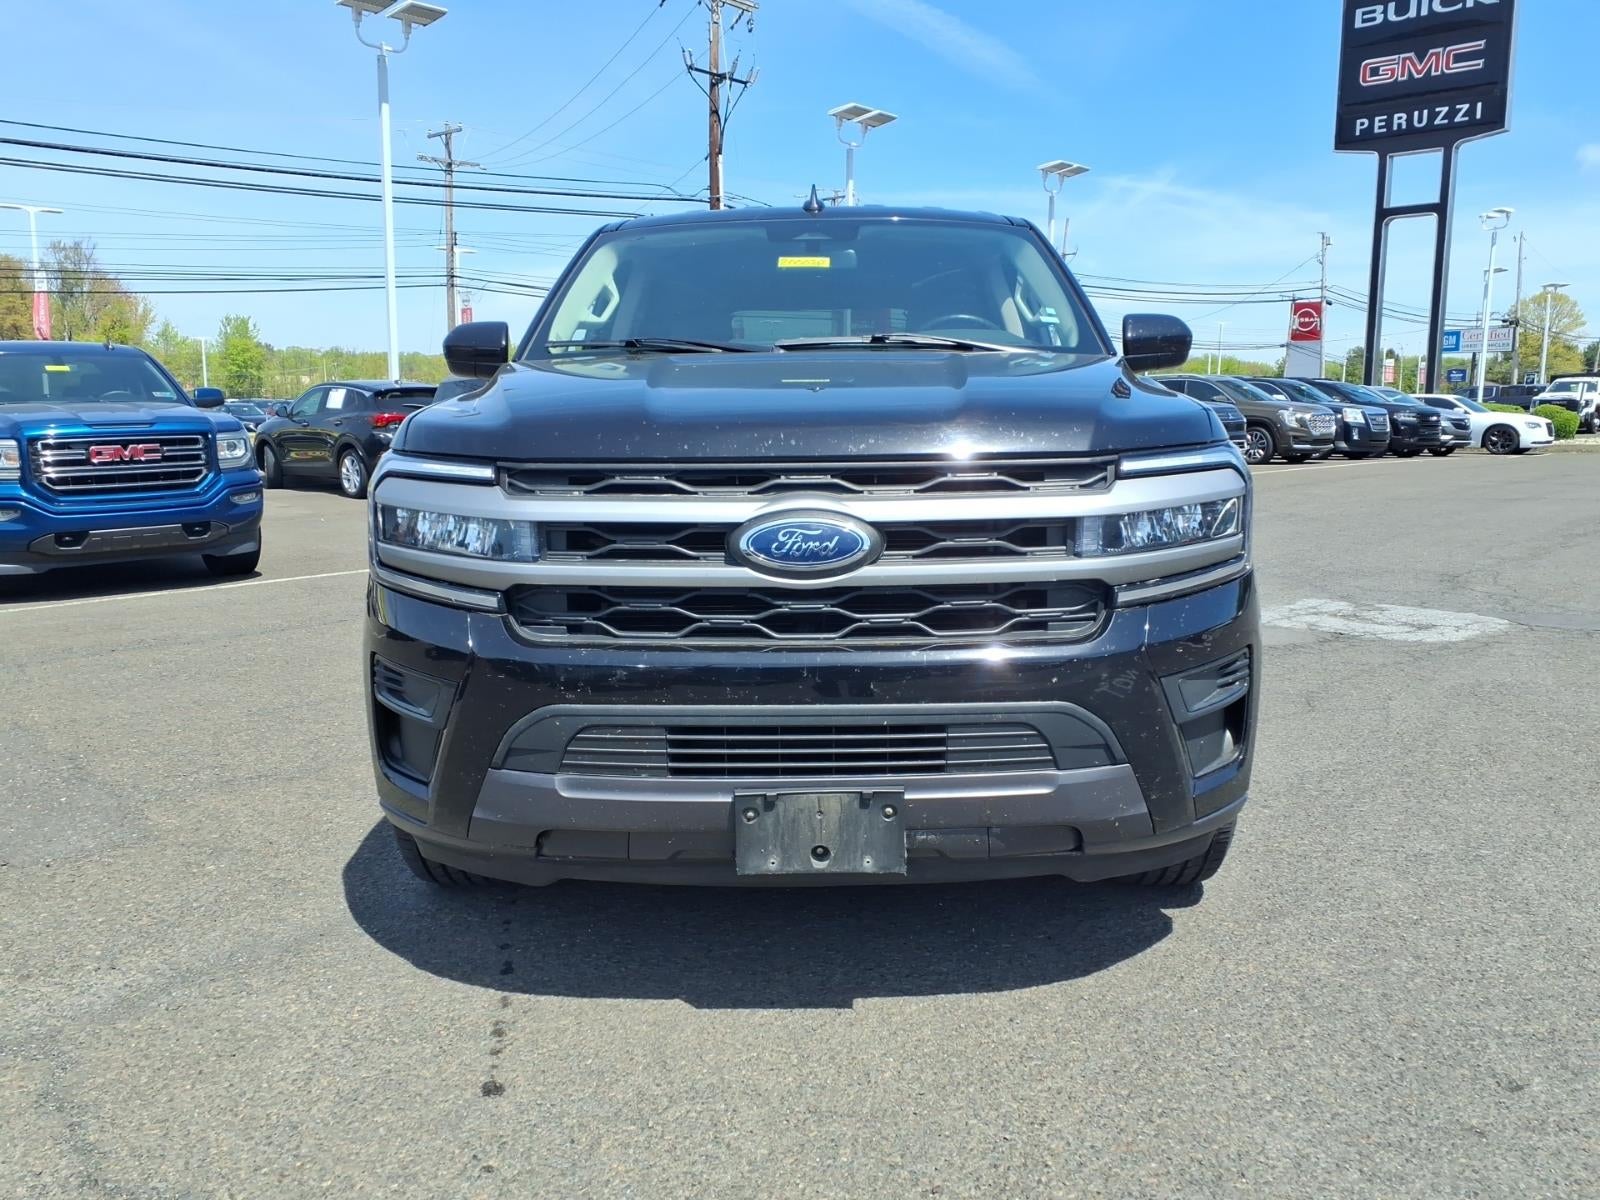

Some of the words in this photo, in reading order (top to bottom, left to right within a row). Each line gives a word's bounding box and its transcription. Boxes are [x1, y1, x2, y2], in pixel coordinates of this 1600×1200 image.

[1359, 39, 1487, 87] GMC
[1355, 101, 1483, 136] PERUZZI
[1462, 328, 1511, 341] Cerfied
[89, 443, 162, 464] GMC
[771, 528, 840, 556] Ford
